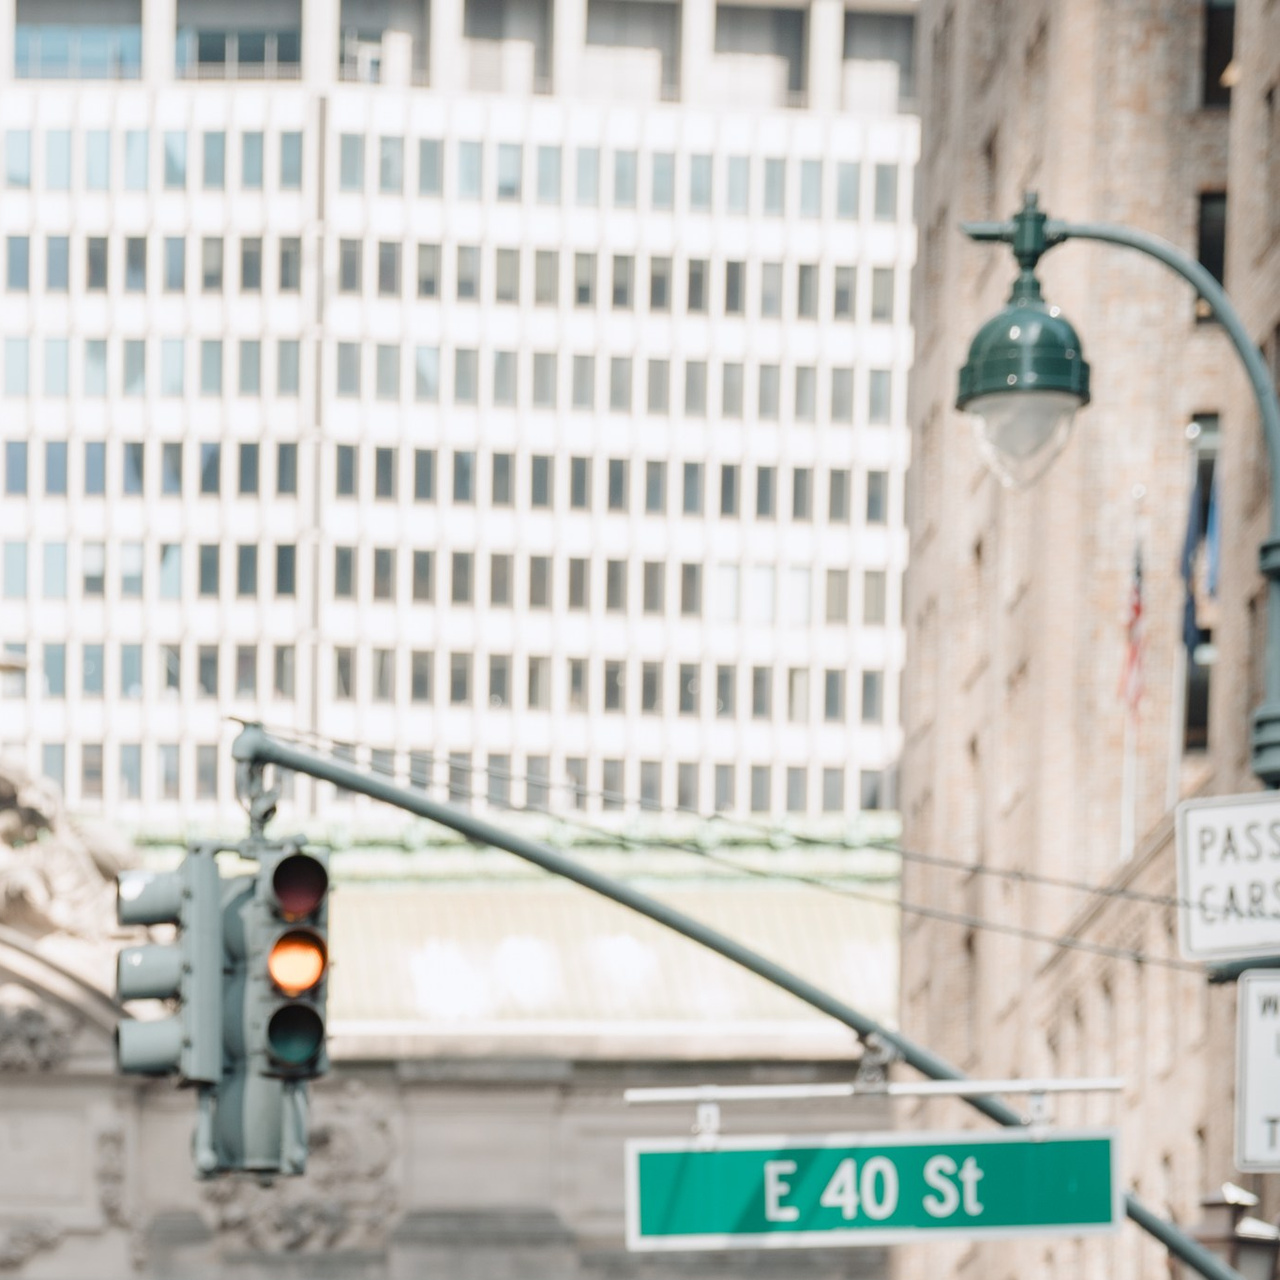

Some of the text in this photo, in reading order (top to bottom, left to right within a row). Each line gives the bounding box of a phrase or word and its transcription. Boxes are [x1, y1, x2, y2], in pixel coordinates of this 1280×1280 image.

[763, 1155, 985, 1222] E 40 St
